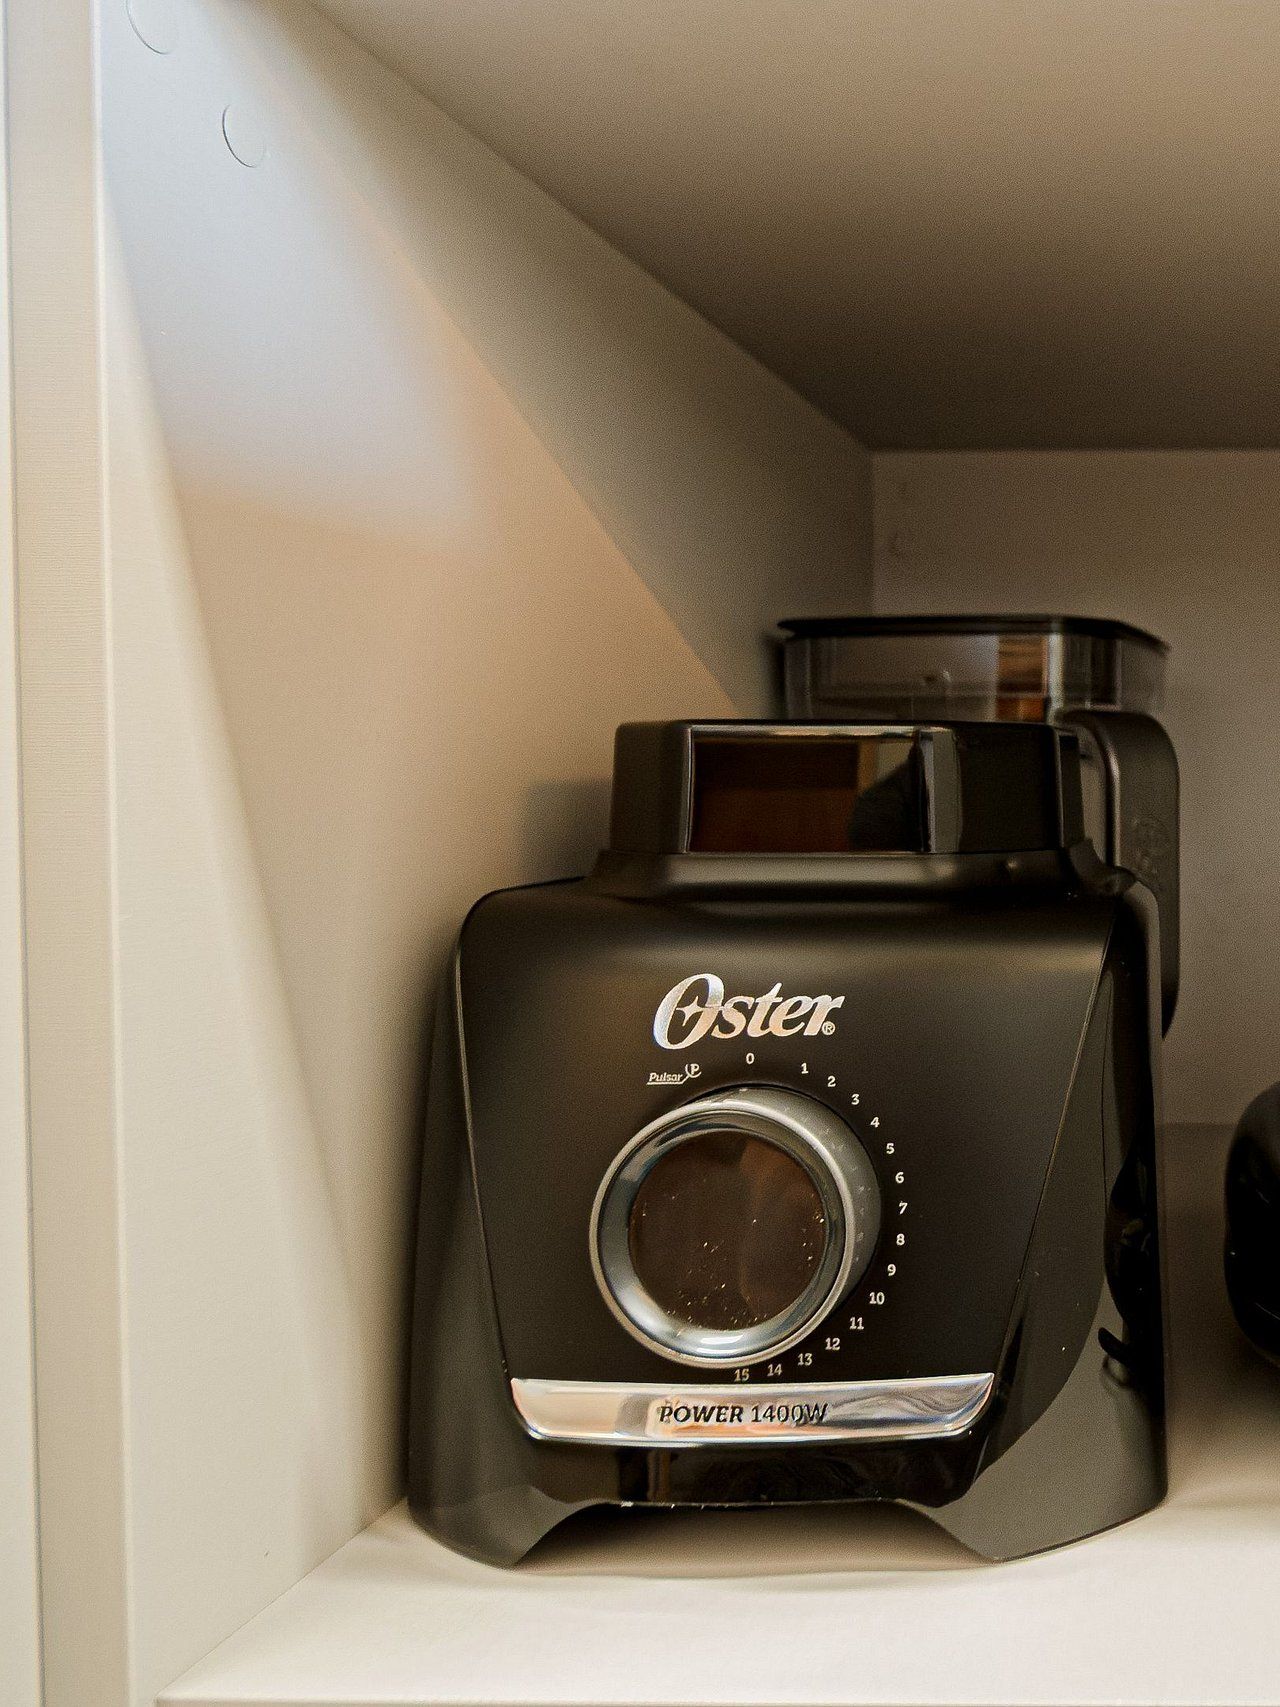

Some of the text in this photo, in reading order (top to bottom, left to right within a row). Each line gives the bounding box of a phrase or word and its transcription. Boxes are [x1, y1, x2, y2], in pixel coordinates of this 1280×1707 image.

[745, 1052, 755, 1065] 0
[800, 1062, 809, 1075] 1
[649, 1071, 684, 1083] Pulsar
[827, 1075, 837, 1088] 2
[851, 1093, 860, 1106] 3
[870, 1116, 880, 1129] 4
[886, 1142, 895, 1155] 5
[895, 1171, 905, 1184] 6
[898, 1200, 908, 1215] 7
[896, 1233, 906, 1246] 8
[887, 1263, 897, 1277] 9
[869, 1291, 885, 1305] 10
[849, 1316, 865, 1330] 11
[825, 1337, 841, 1351] 12
[797, 1352, 813, 1366] 13
[734, 1368, 750, 1382] 15
[767, 1363, 783, 1377] 14
[658, 1402, 829, 1424] POWER 1400W
